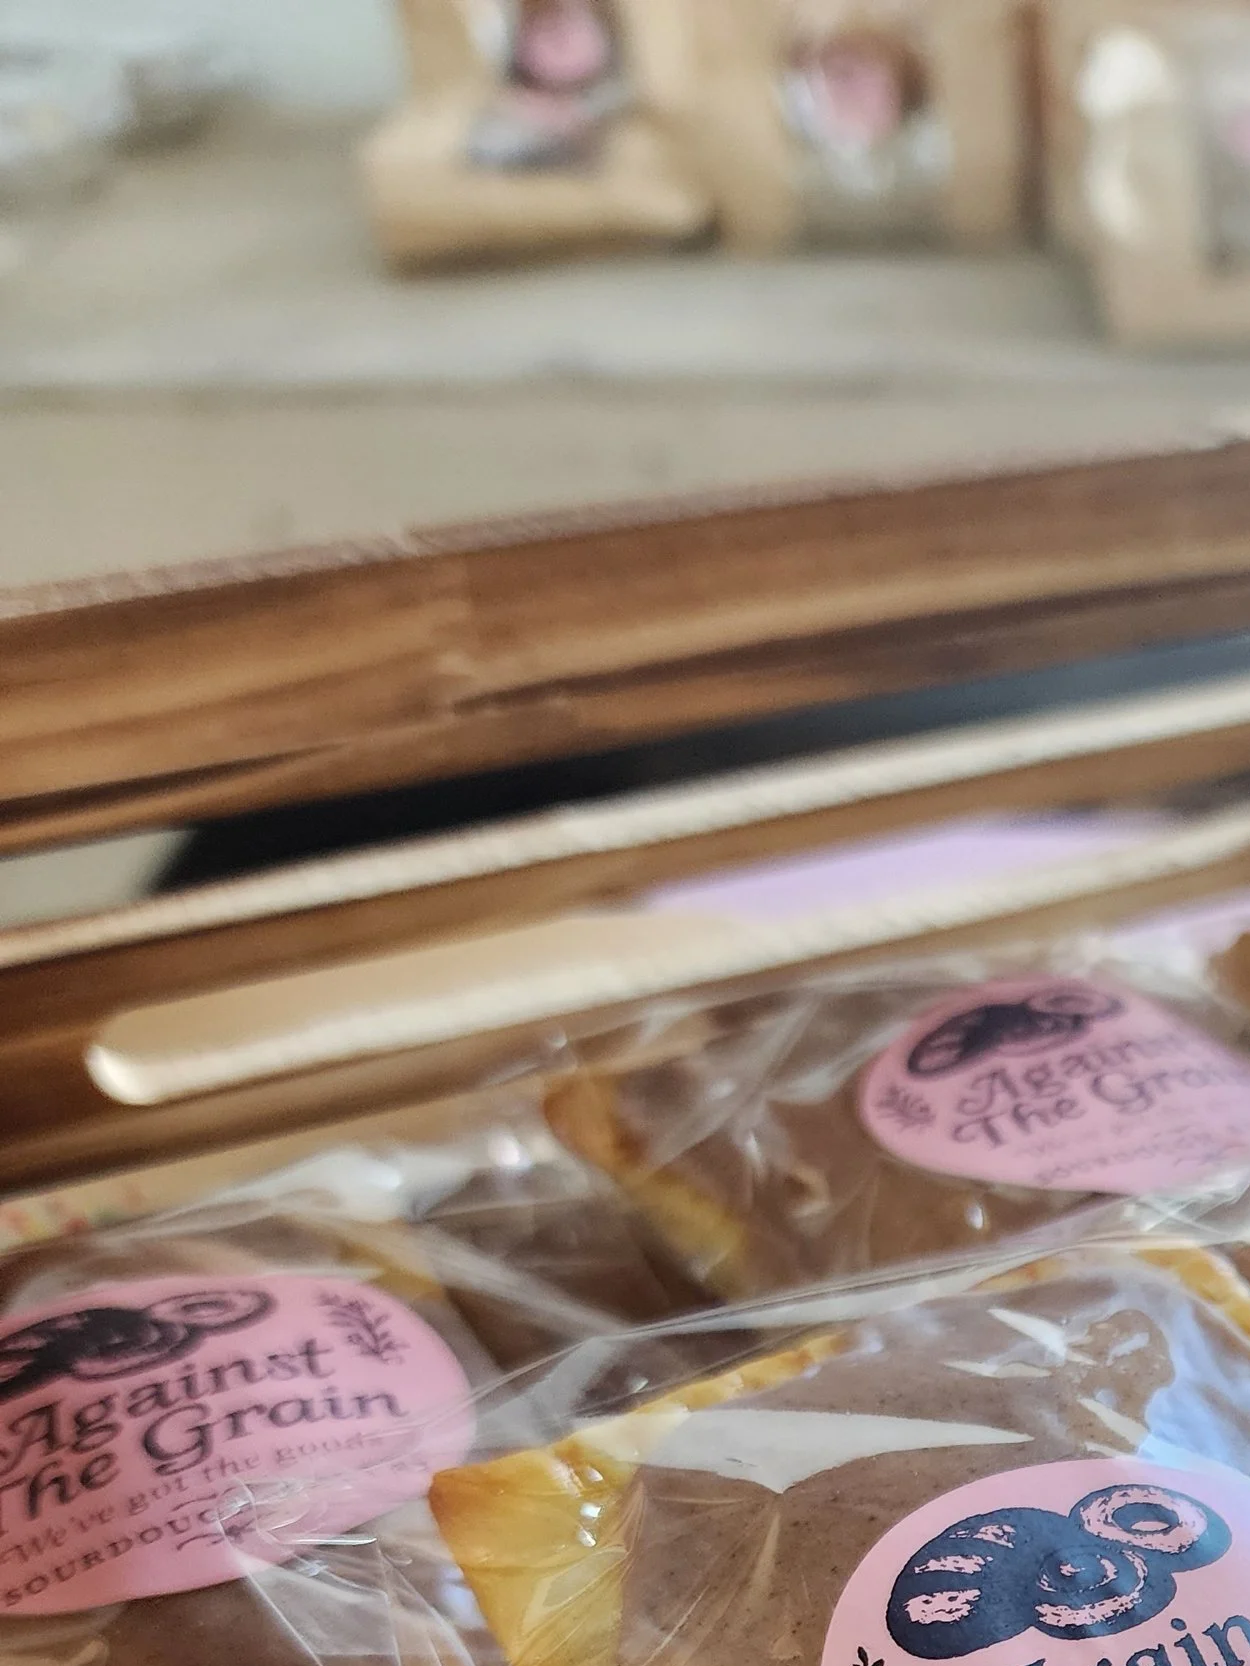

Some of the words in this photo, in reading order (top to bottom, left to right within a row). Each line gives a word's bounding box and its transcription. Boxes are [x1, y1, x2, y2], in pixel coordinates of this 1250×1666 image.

[952, 1097, 1088, 1149] The
[0, 1335, 336, 1478] Against
[0, 1453, 121, 1537] he
[142, 1386, 407, 1476] Grain
